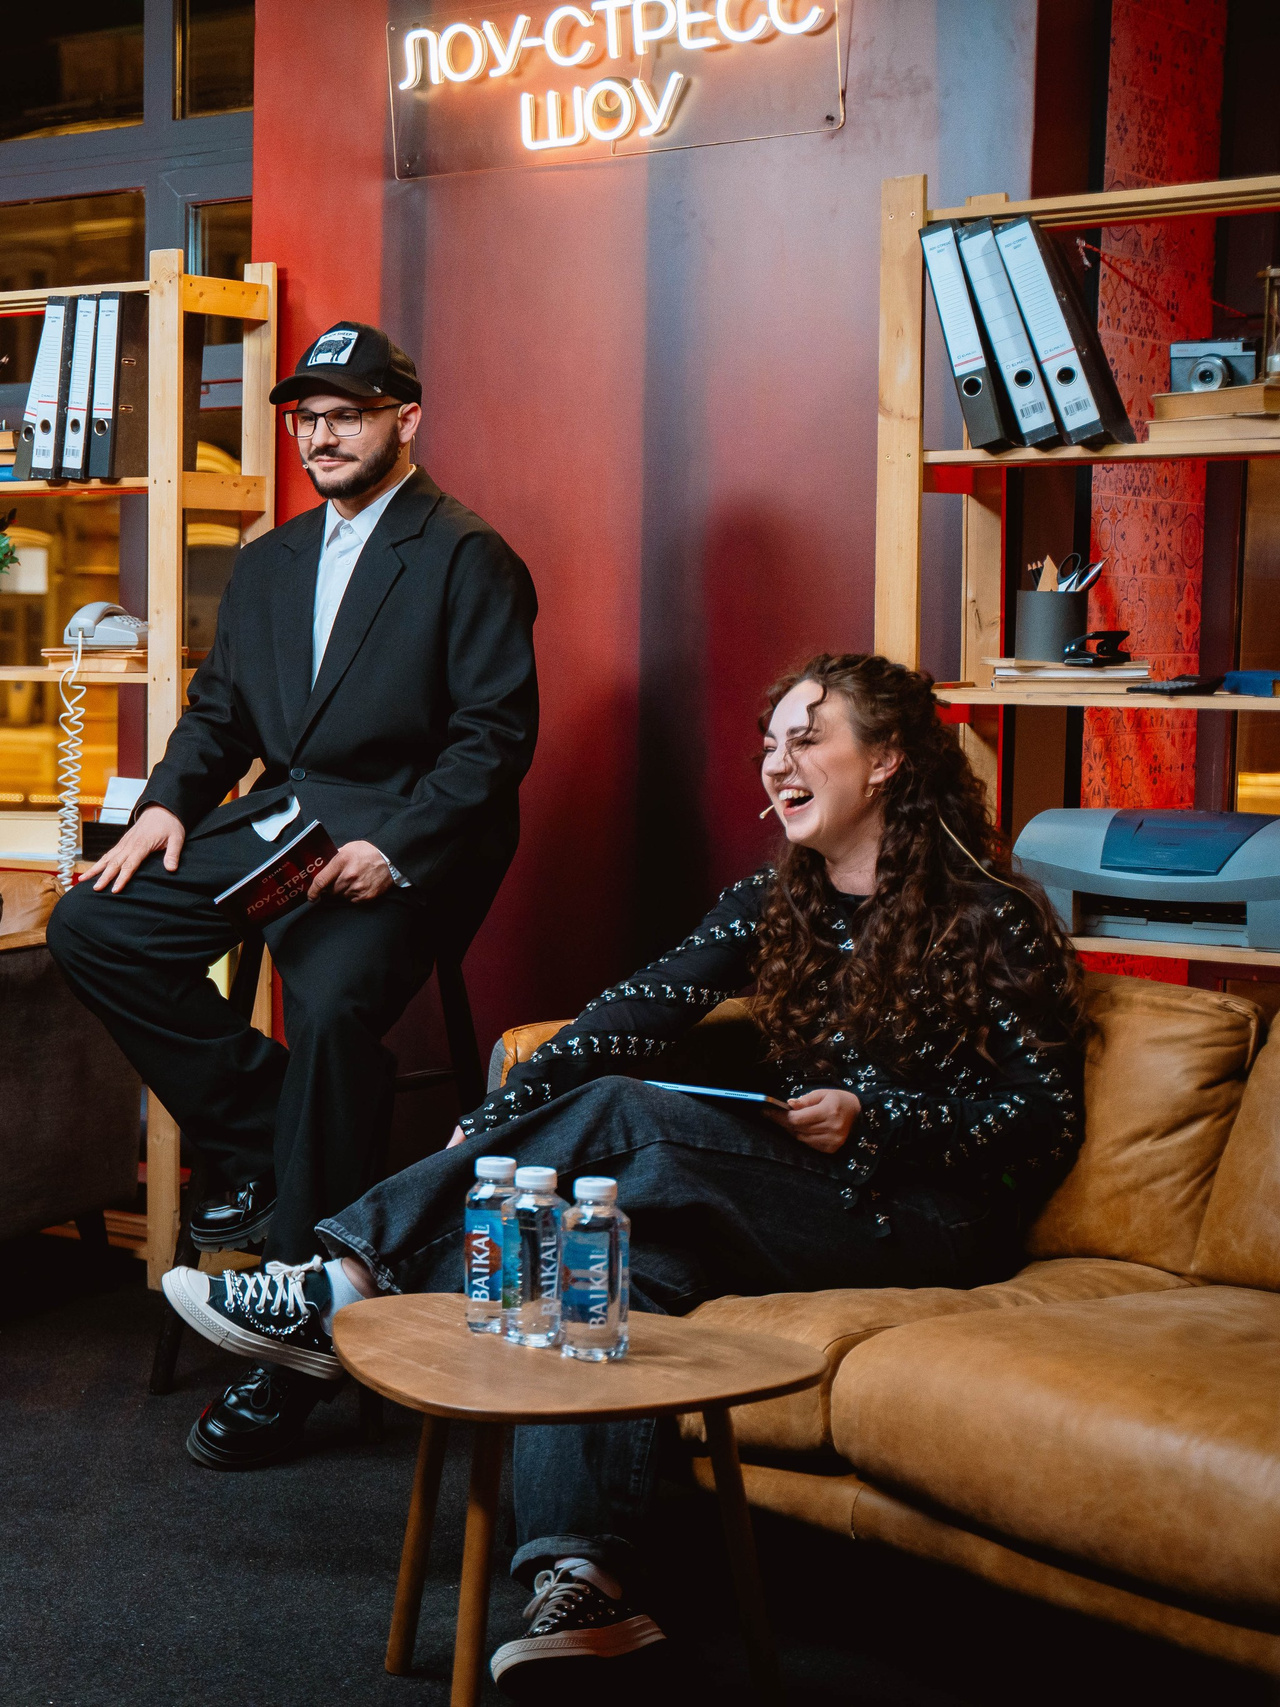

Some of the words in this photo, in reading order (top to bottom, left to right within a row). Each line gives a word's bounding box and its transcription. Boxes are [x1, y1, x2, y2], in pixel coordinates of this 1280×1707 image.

[399, 0, 825, 90] ЛОУ-СТРЕСС
[521, 72, 684, 151] ШОУ
[246, 857, 324, 915] ЛОУ-СТРЕСС
[277, 884, 304, 906] ШОУ
[472, 1224, 490, 1302] BAIKAL
[540, 1234, 557, 1315] BAIKAL
[589, 1248, 608, 1330] BAIKAL
